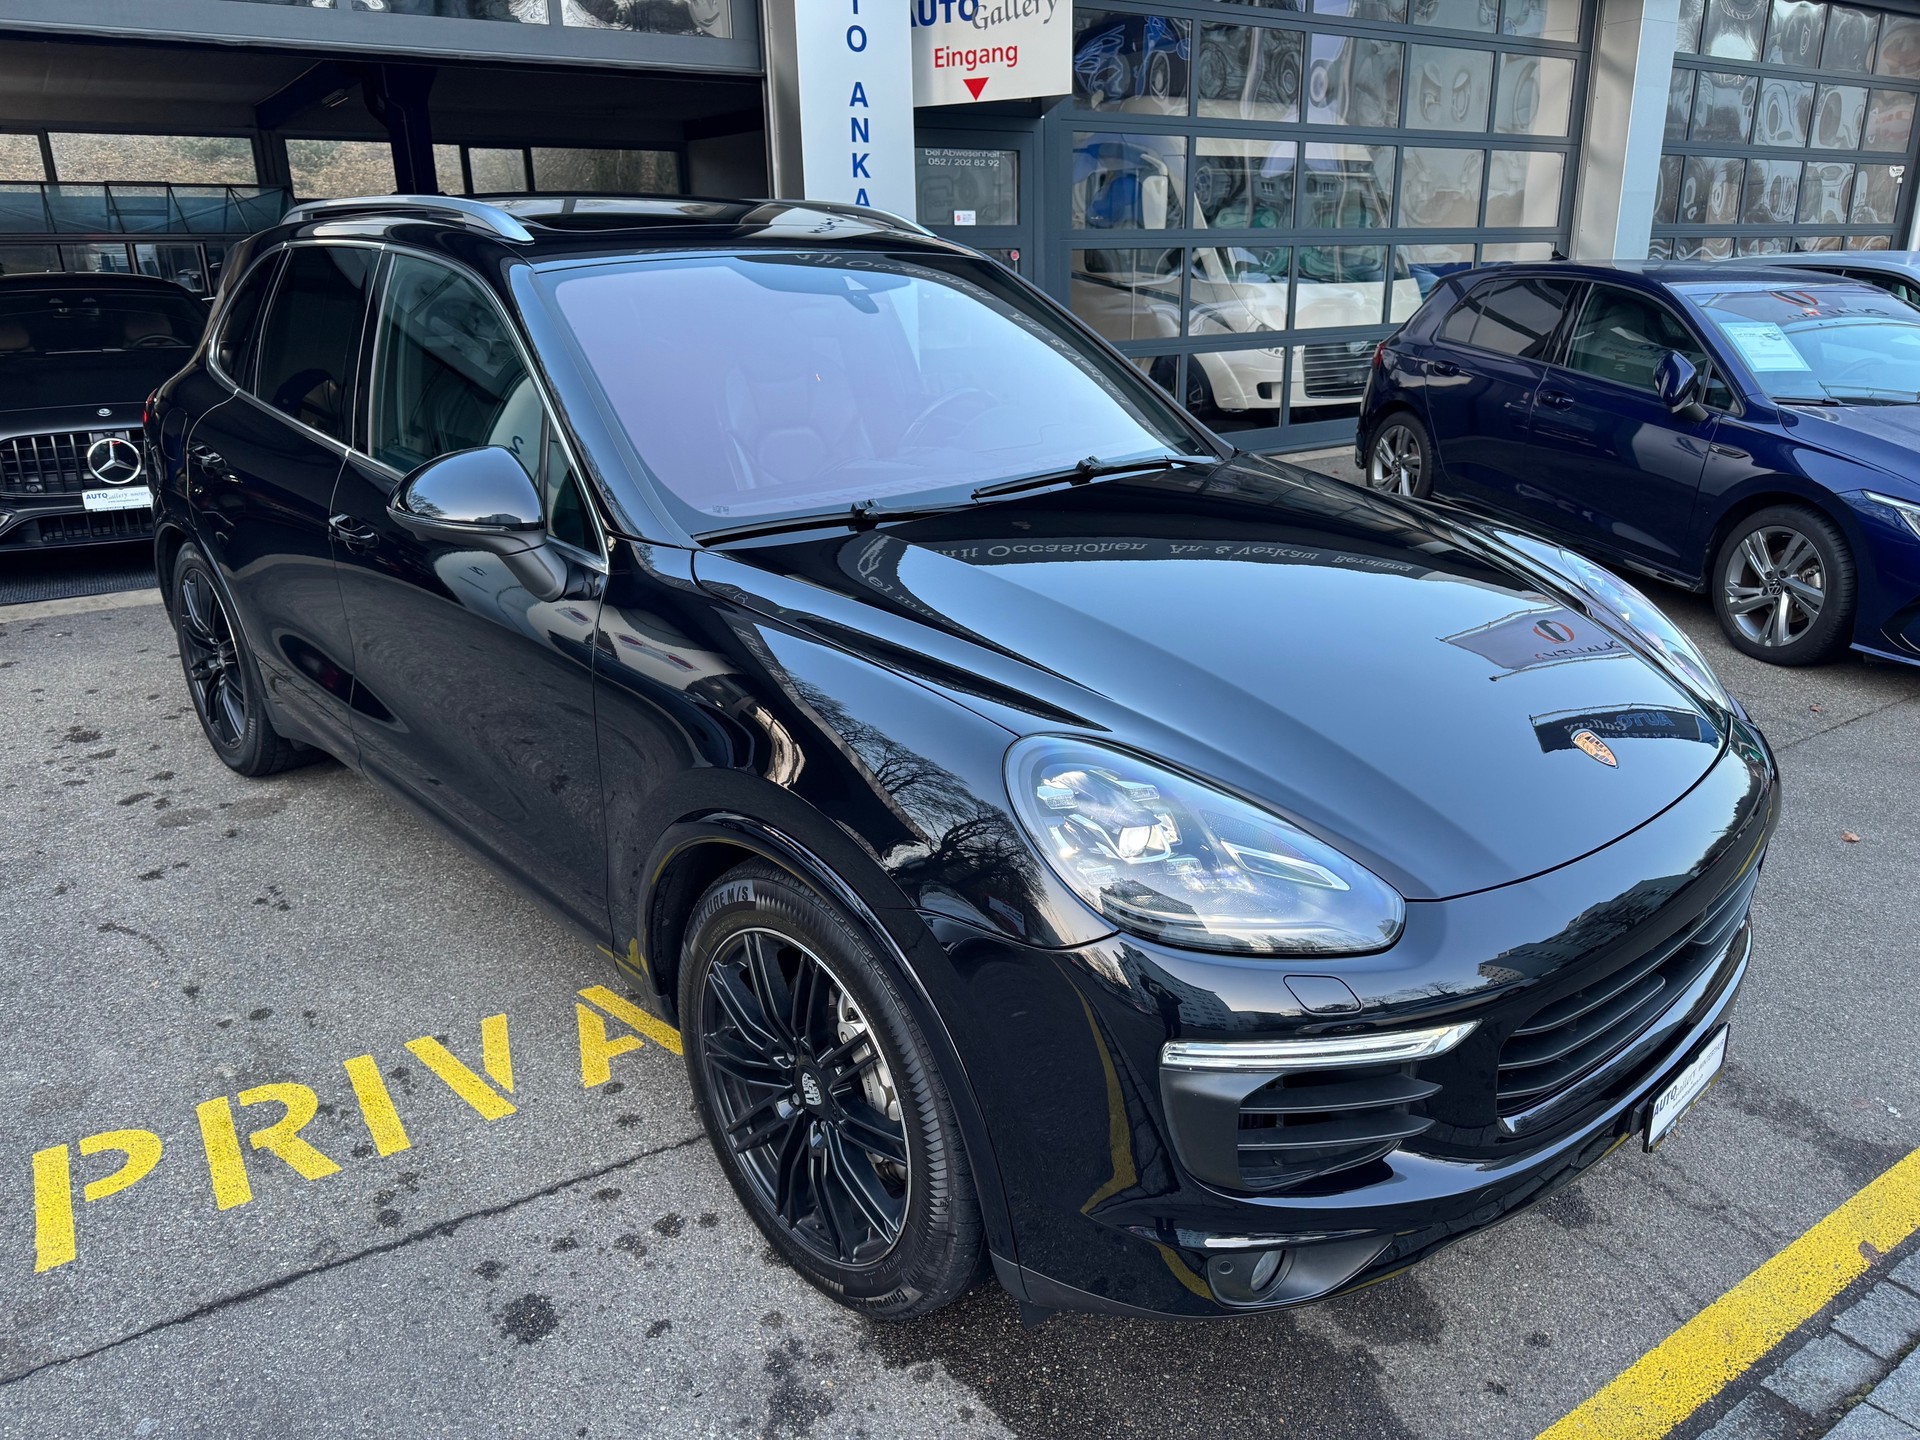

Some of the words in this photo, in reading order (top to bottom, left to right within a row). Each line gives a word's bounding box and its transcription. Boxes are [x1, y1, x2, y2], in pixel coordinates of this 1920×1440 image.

[911, 0, 980, 27] UTO
[972, 0, 1058, 30] Gallery
[934, 45, 1019, 71] Eingang
[849, 81, 871, 207] ANKA
[928, 157, 947, 166] 052
[954, 158, 972, 167] 202
[974, 159, 987, 167] 82
[988, 159, 1000, 168] 92
[86, 492, 108, 500] AUTO
[1653, 1084, 1679, 1116] AUTO
[33, 985, 684, 1274] PRIVA
